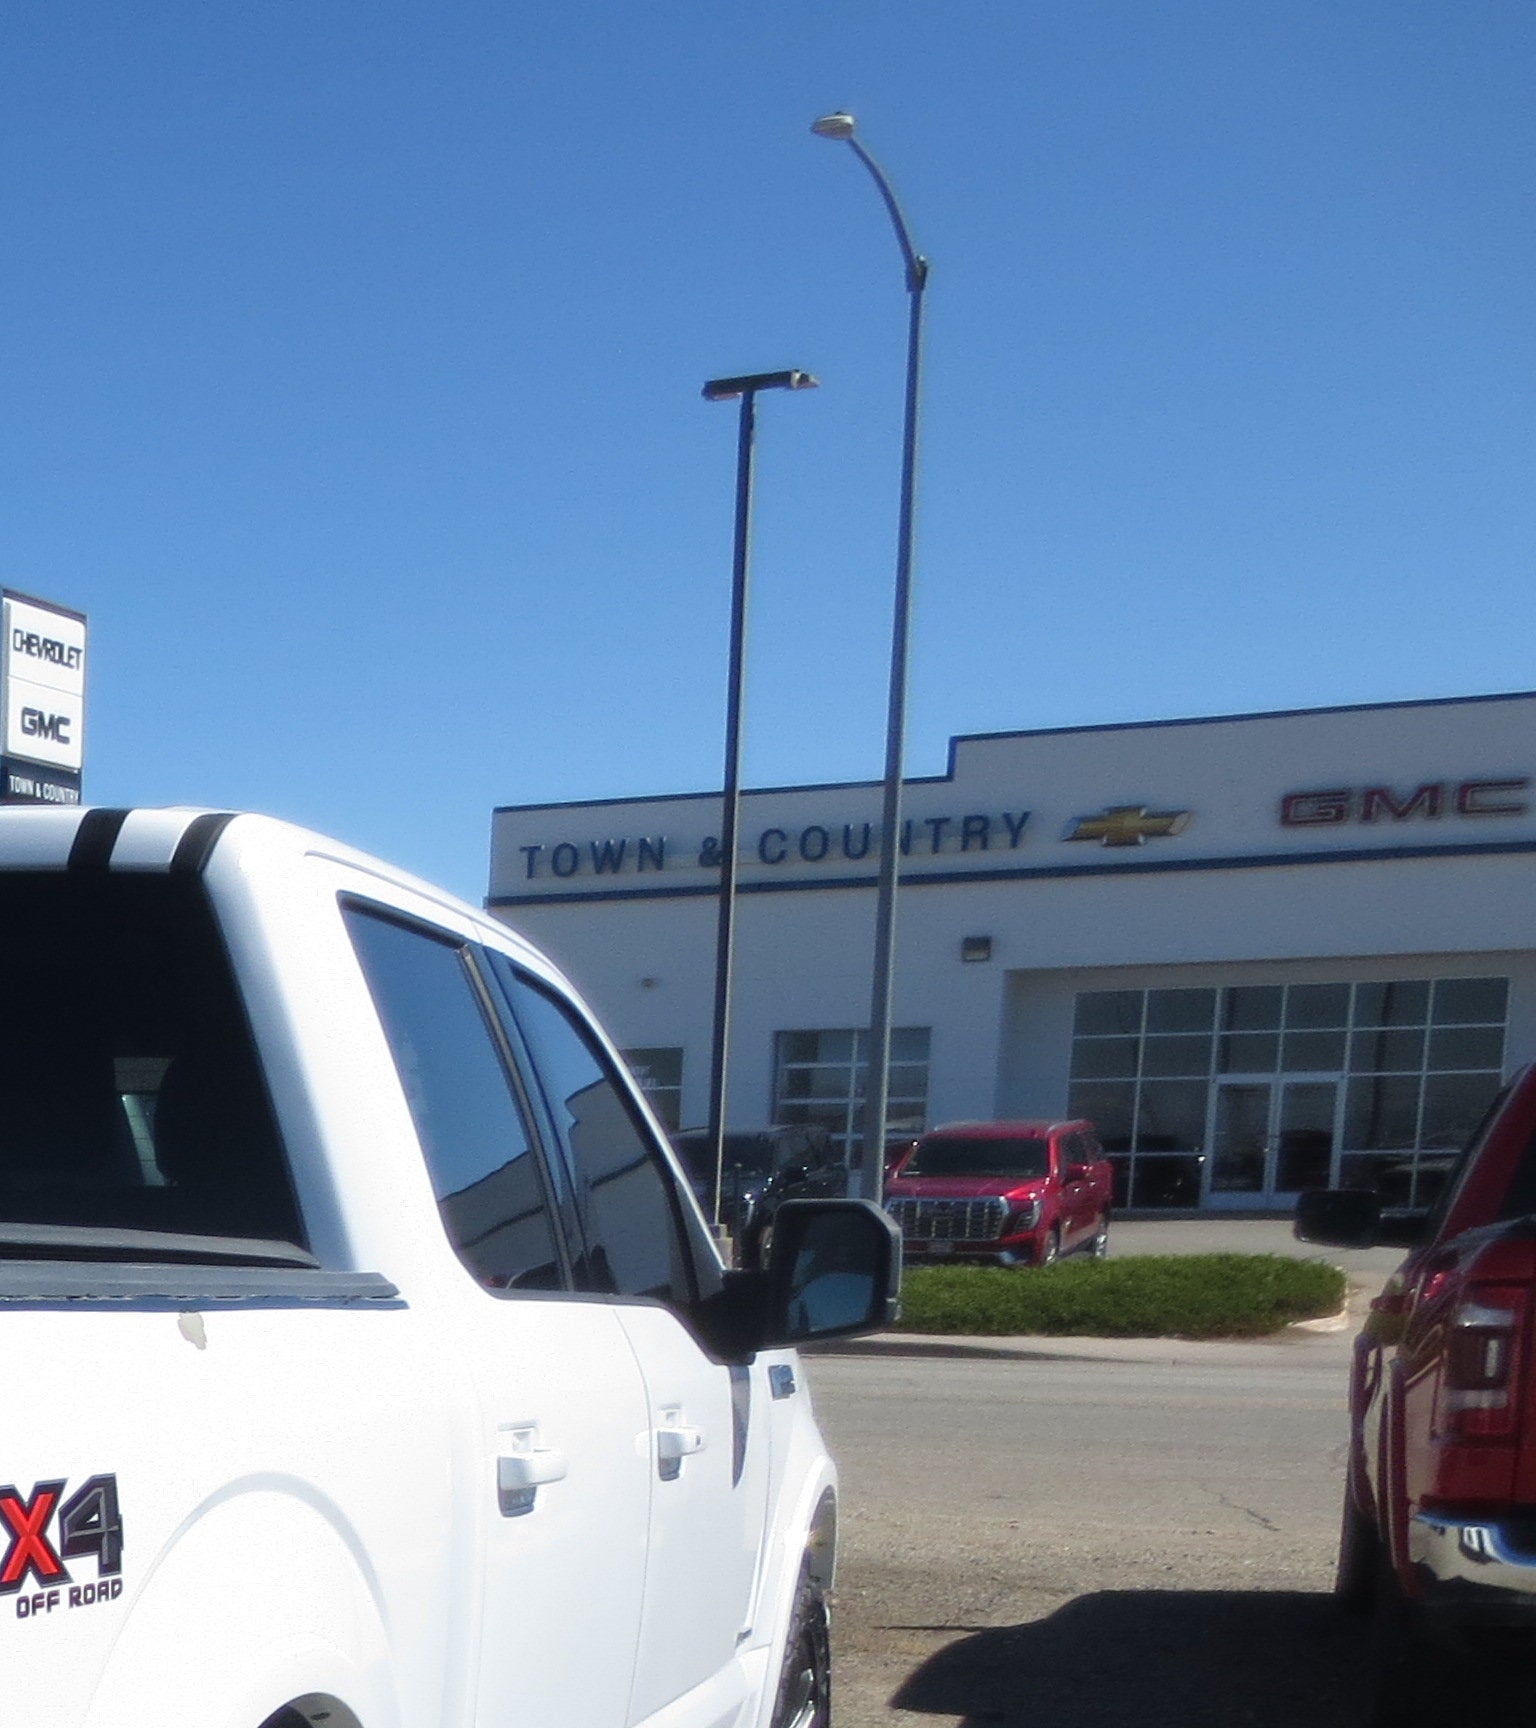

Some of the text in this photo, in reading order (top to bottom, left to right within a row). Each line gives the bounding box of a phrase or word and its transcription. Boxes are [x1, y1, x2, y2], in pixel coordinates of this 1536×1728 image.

[13, 628, 83, 671] CHEVROLET
[21, 706, 71, 745] GMC
[9, 775, 34, 795] TOWN
[43, 783, 79, 805] COUNTRY
[1280, 776, 1528, 827] GMC
[519, 836, 667, 879] TOWN
[698, 836, 726, 868] &
[16, 1578, 123, 1619] OFF ROAD
